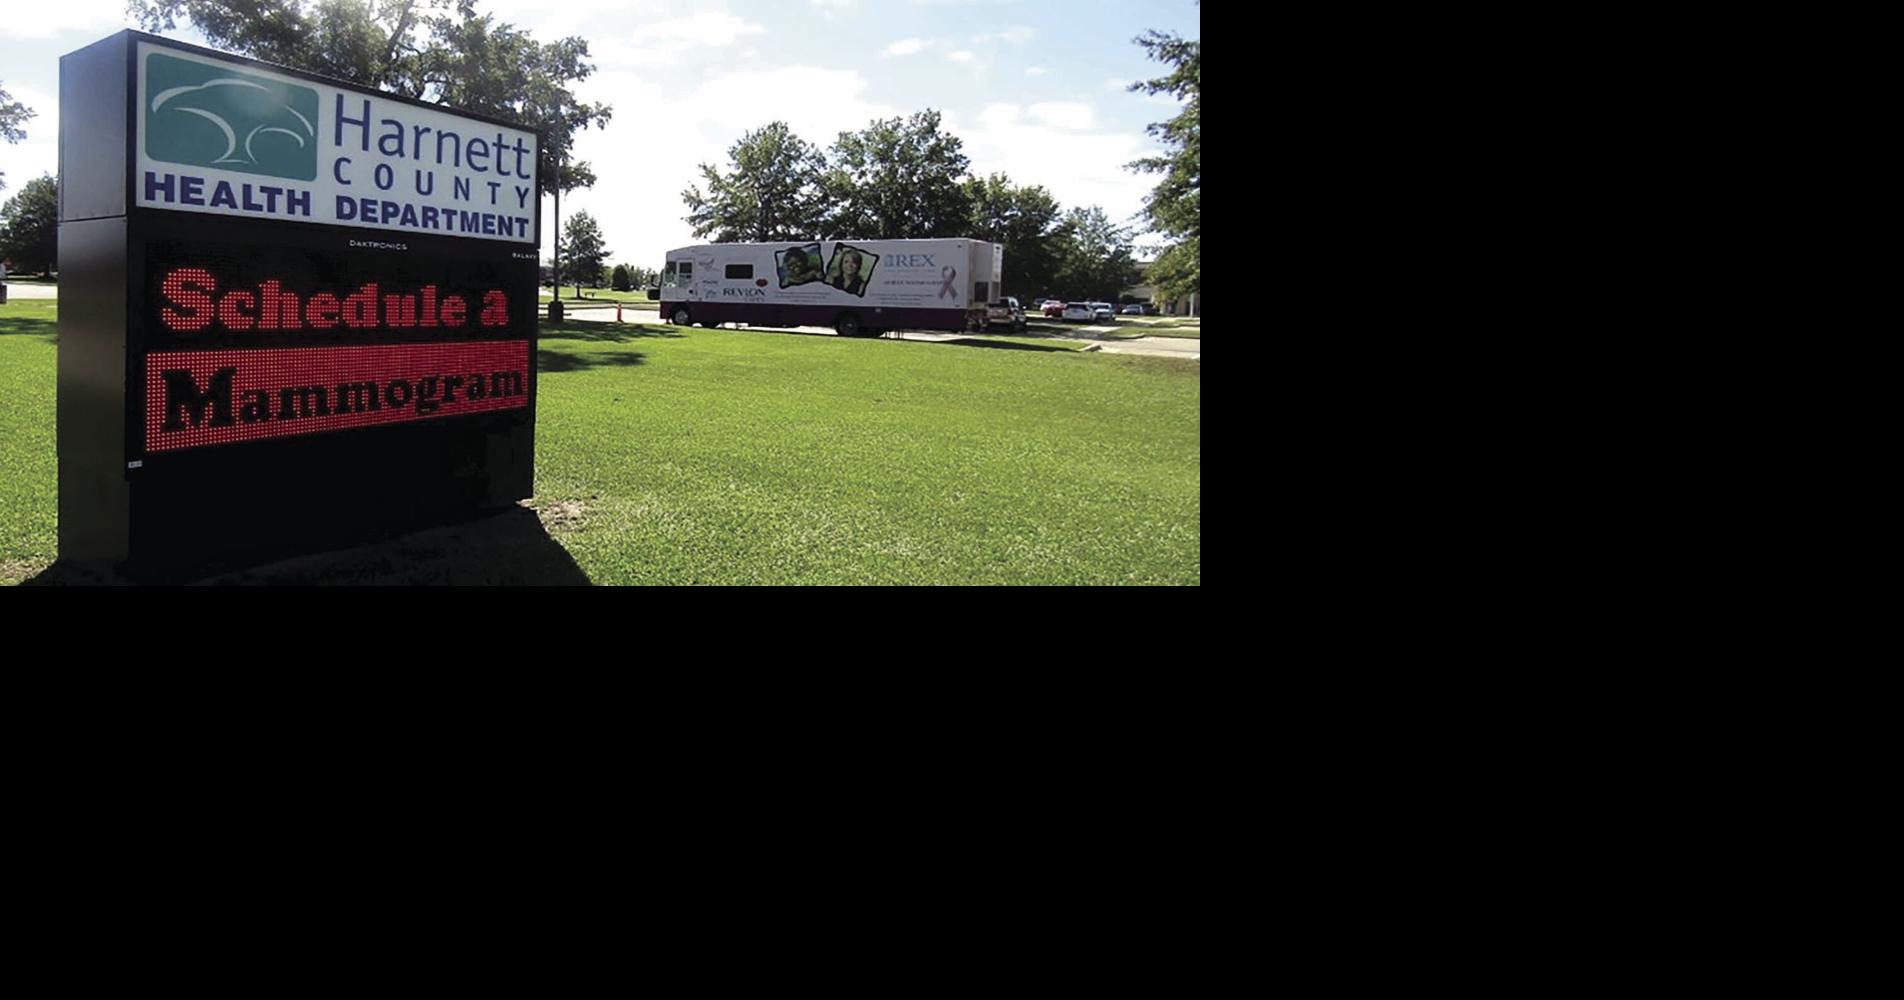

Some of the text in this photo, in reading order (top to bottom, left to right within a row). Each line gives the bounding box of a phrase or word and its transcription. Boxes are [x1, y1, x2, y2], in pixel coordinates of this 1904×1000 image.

[333, 93, 531, 180] Harnett
[144, 171, 530, 239] HEALTH DEPARTMENT
[333, 157, 530, 209] COUNTY
[349, 239, 408, 250] DAKTRONICS
[895, 254, 936, 267] REX
[162, 268, 510, 331] Schedule a
[723, 287, 767, 297] REVLON
[160, 366, 524, 434] Mammogram
